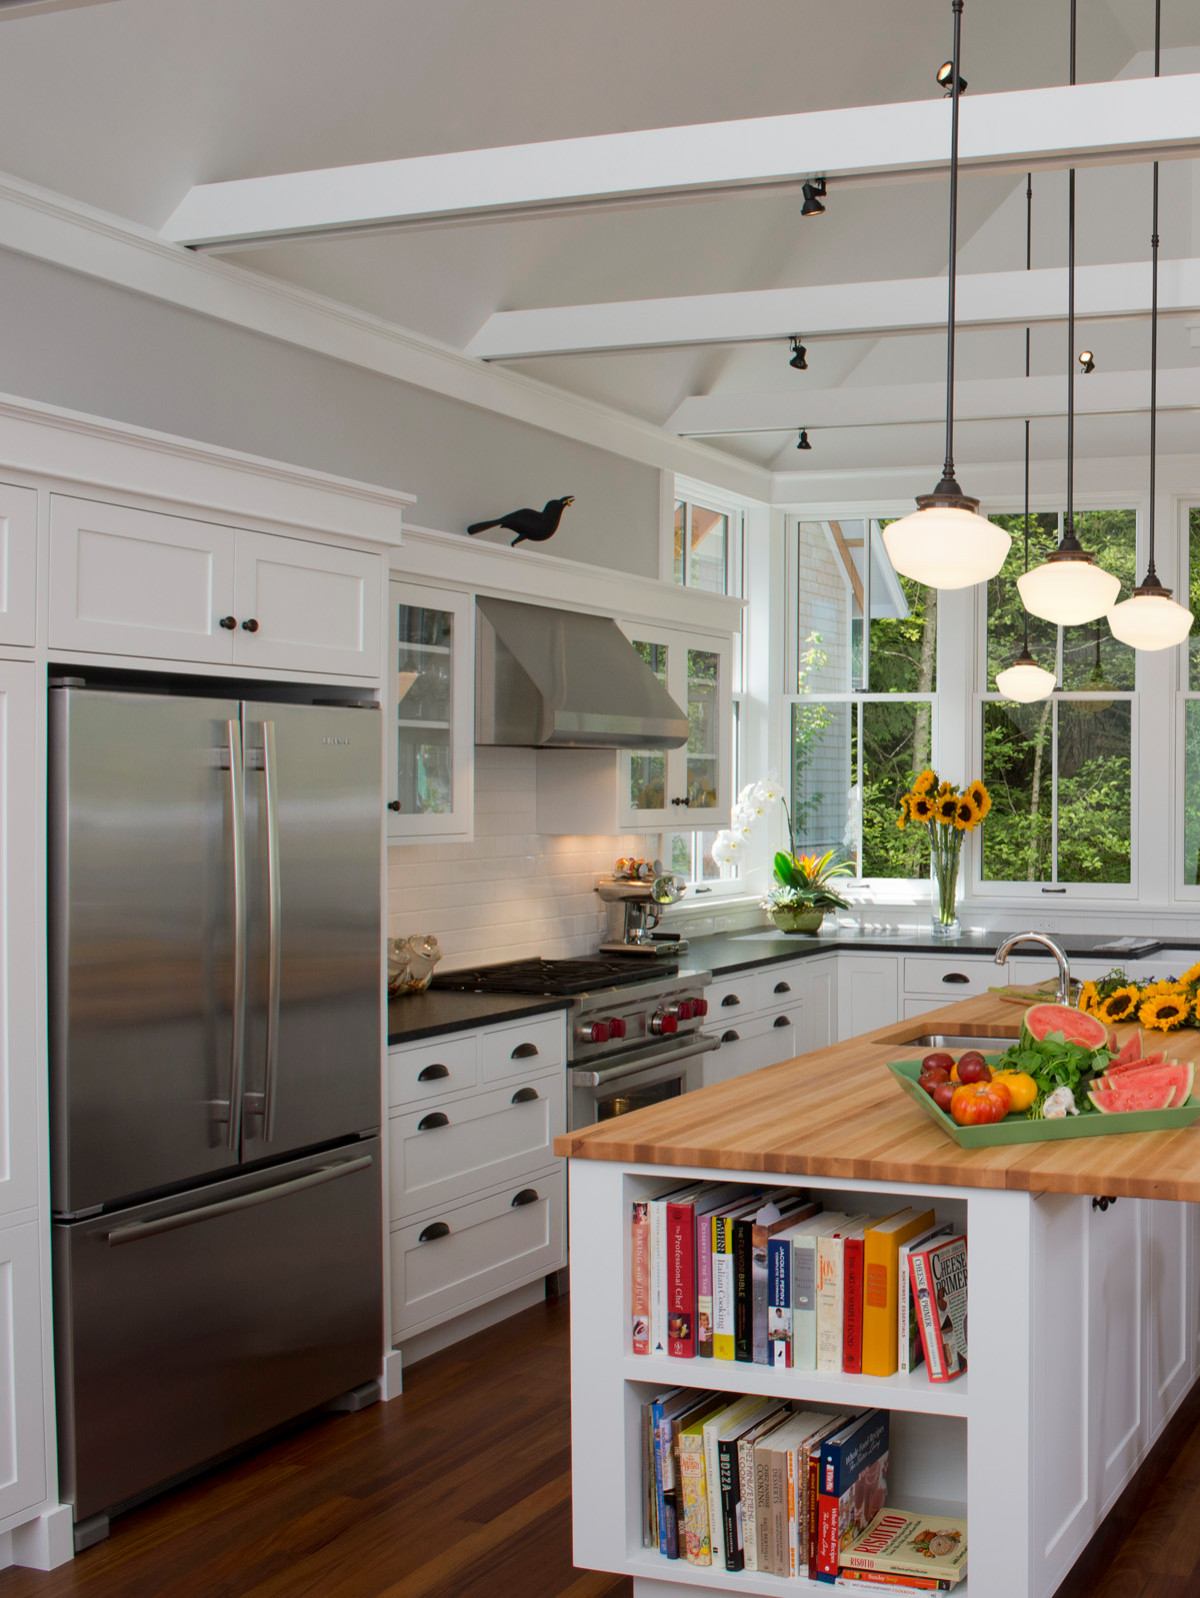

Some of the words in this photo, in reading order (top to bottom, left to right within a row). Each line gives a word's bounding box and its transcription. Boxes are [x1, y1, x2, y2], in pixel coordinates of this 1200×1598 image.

[636, 1229, 644, 1263] BAKING
[674, 1235, 683, 1286] Professional
[636, 1266, 644, 1283] with
[716, 1259, 726, 1290] Italian
[932, 1252, 967, 1281] CHEESE
[636, 1284, 644, 1310] JULIA
[674, 1288, 683, 1310] Chef
[914, 1258, 925, 1287] CHEESE
[921, 1300, 932, 1328] PRIMER
[716, 1290, 727, 1329] Cooking
[847, 1296, 855, 1323] SIMPLE
[847, 1324, 855, 1348] FOOD
[661, 1427, 669, 1464] wholesome
[720, 1454, 732, 1491] MOZZA
[739, 1456, 747, 1509] COOKBOOK
[757, 1464, 765, 1508] COOKING
[747, 1499, 755, 1522] MENU
[853, 1515, 908, 1554] RISOTTO
[850, 1557, 875, 1568] RISOTTO
